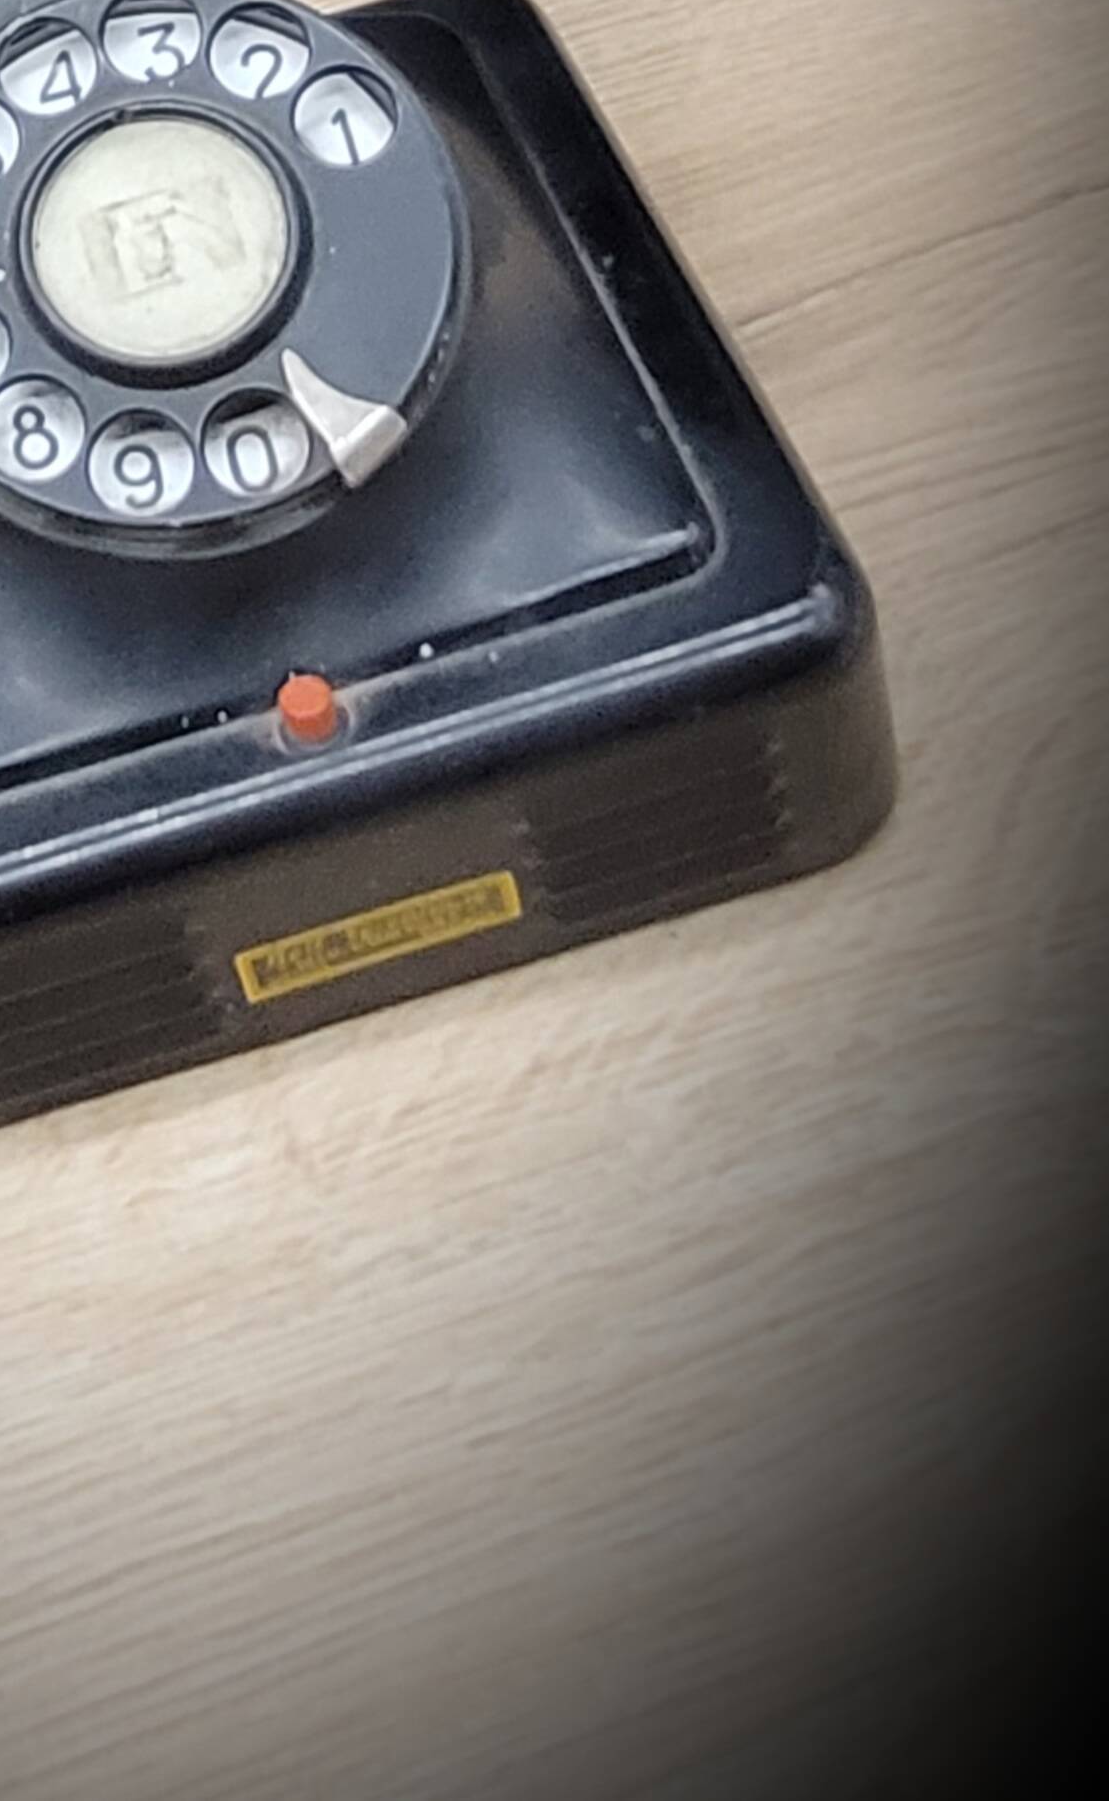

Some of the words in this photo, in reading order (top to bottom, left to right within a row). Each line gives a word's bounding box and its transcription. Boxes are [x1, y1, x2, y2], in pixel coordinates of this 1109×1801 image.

[39, 50, 82, 105] 4
[136, 22, 186, 82] 3
[241, 43, 282, 99] 2
[330, 108, 361, 166] 1
[11, 406, 59, 470] 8
[226, 425, 278, 493] 0
[113, 444, 163, 510] 9
